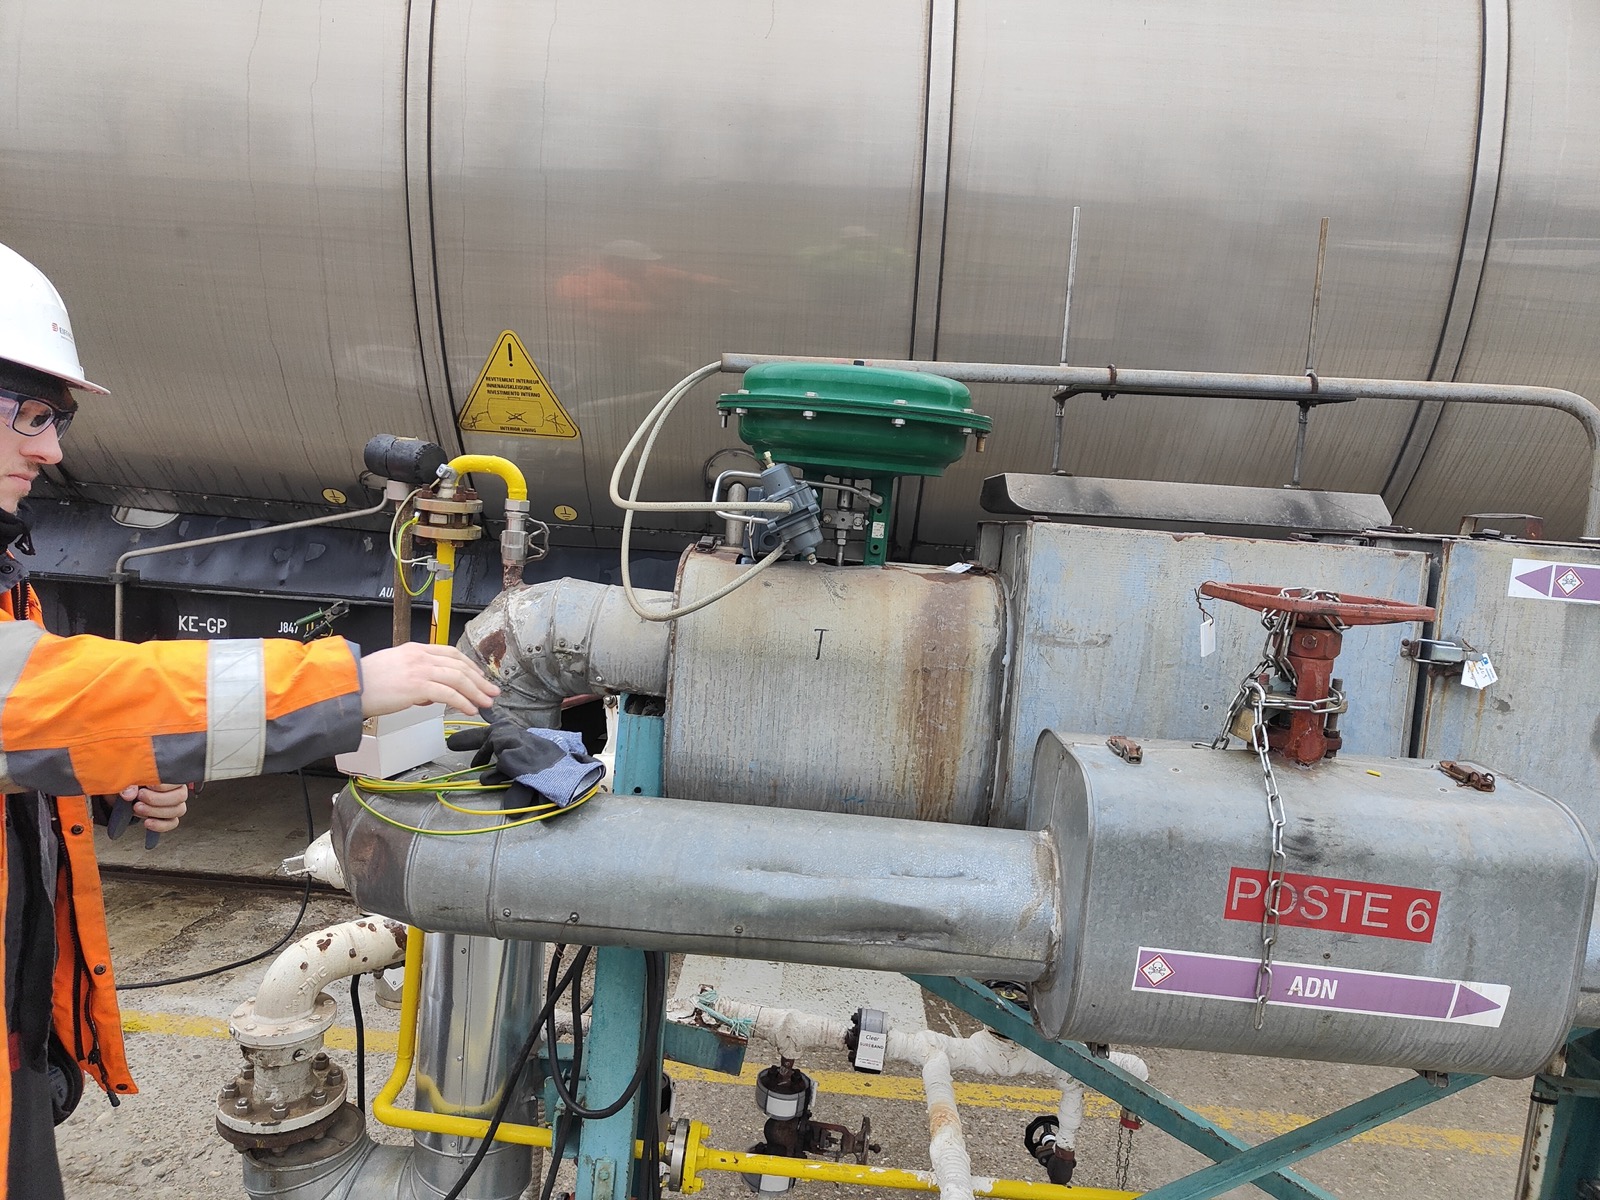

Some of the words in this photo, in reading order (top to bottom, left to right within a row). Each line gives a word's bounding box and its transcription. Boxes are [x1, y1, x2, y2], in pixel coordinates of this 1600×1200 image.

[178, 615, 227, 634] KE-GP
[814, 628, 829, 660] T
[1231, 876, 1393, 929] POSTE
[1405, 898, 1432, 934] 6
[1287, 975, 1339, 1000] ADN
[859, 1041, 885, 1050] SUREBAND
[865, 1034, 880, 1042] Clear
